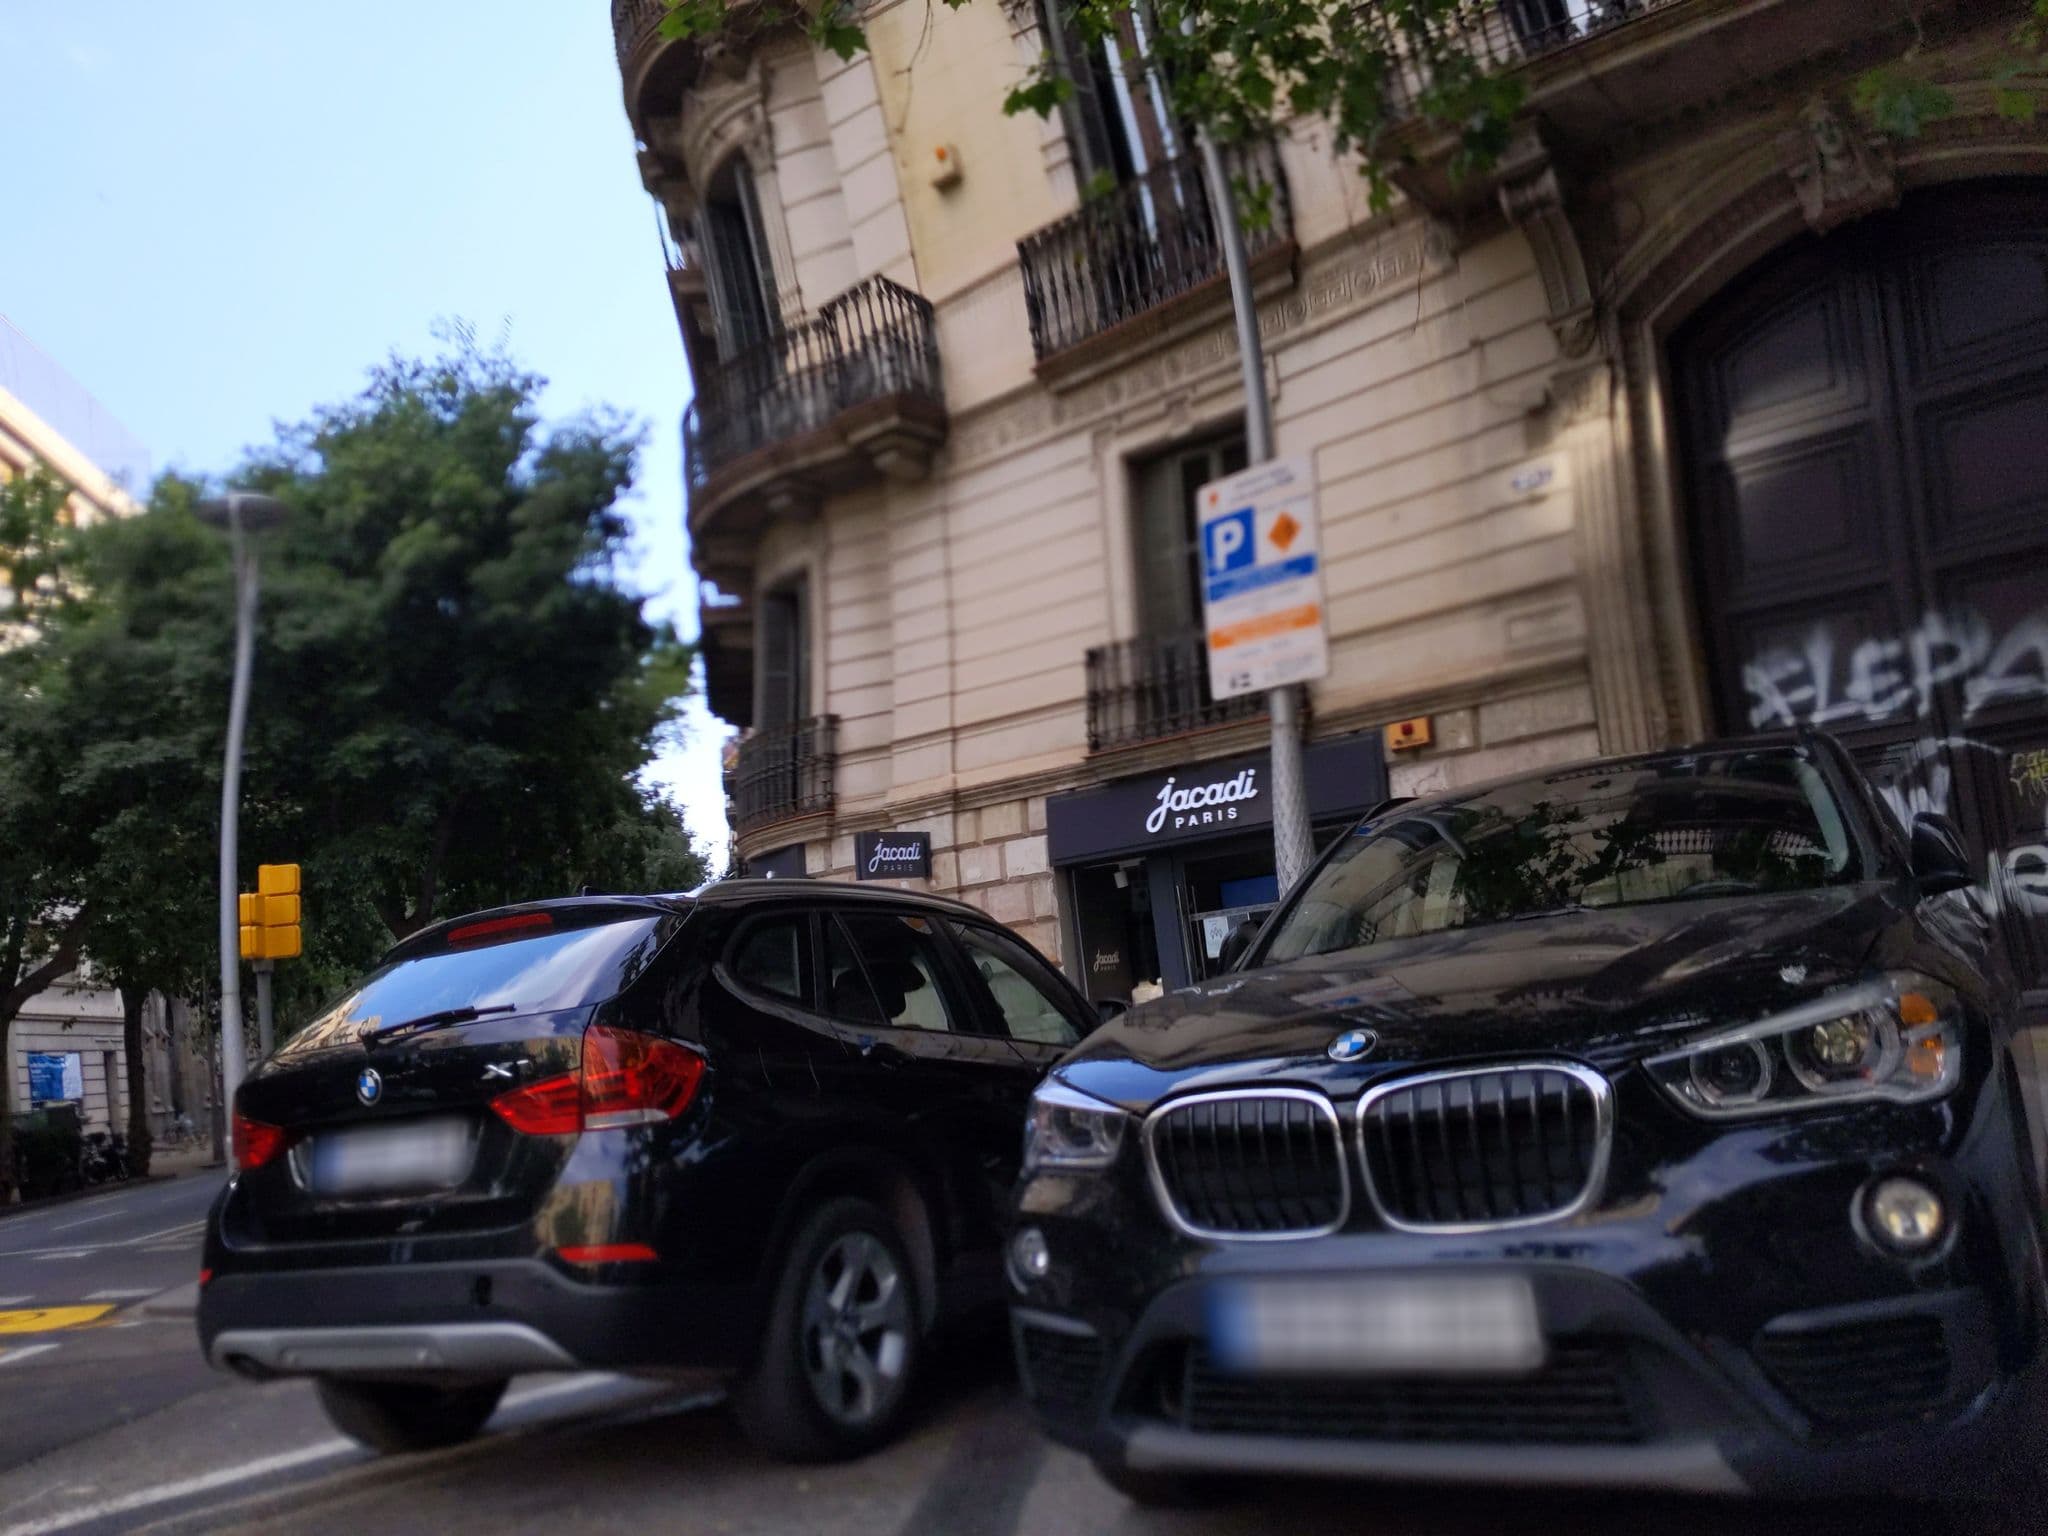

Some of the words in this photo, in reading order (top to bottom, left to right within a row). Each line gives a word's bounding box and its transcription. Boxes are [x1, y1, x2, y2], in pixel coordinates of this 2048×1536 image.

[1211, 517, 1245, 571] P
[1146, 768, 1258, 833] jacadi
[1175, 807, 1238, 829] PARIS
[868, 838, 921, 873] jacadi
